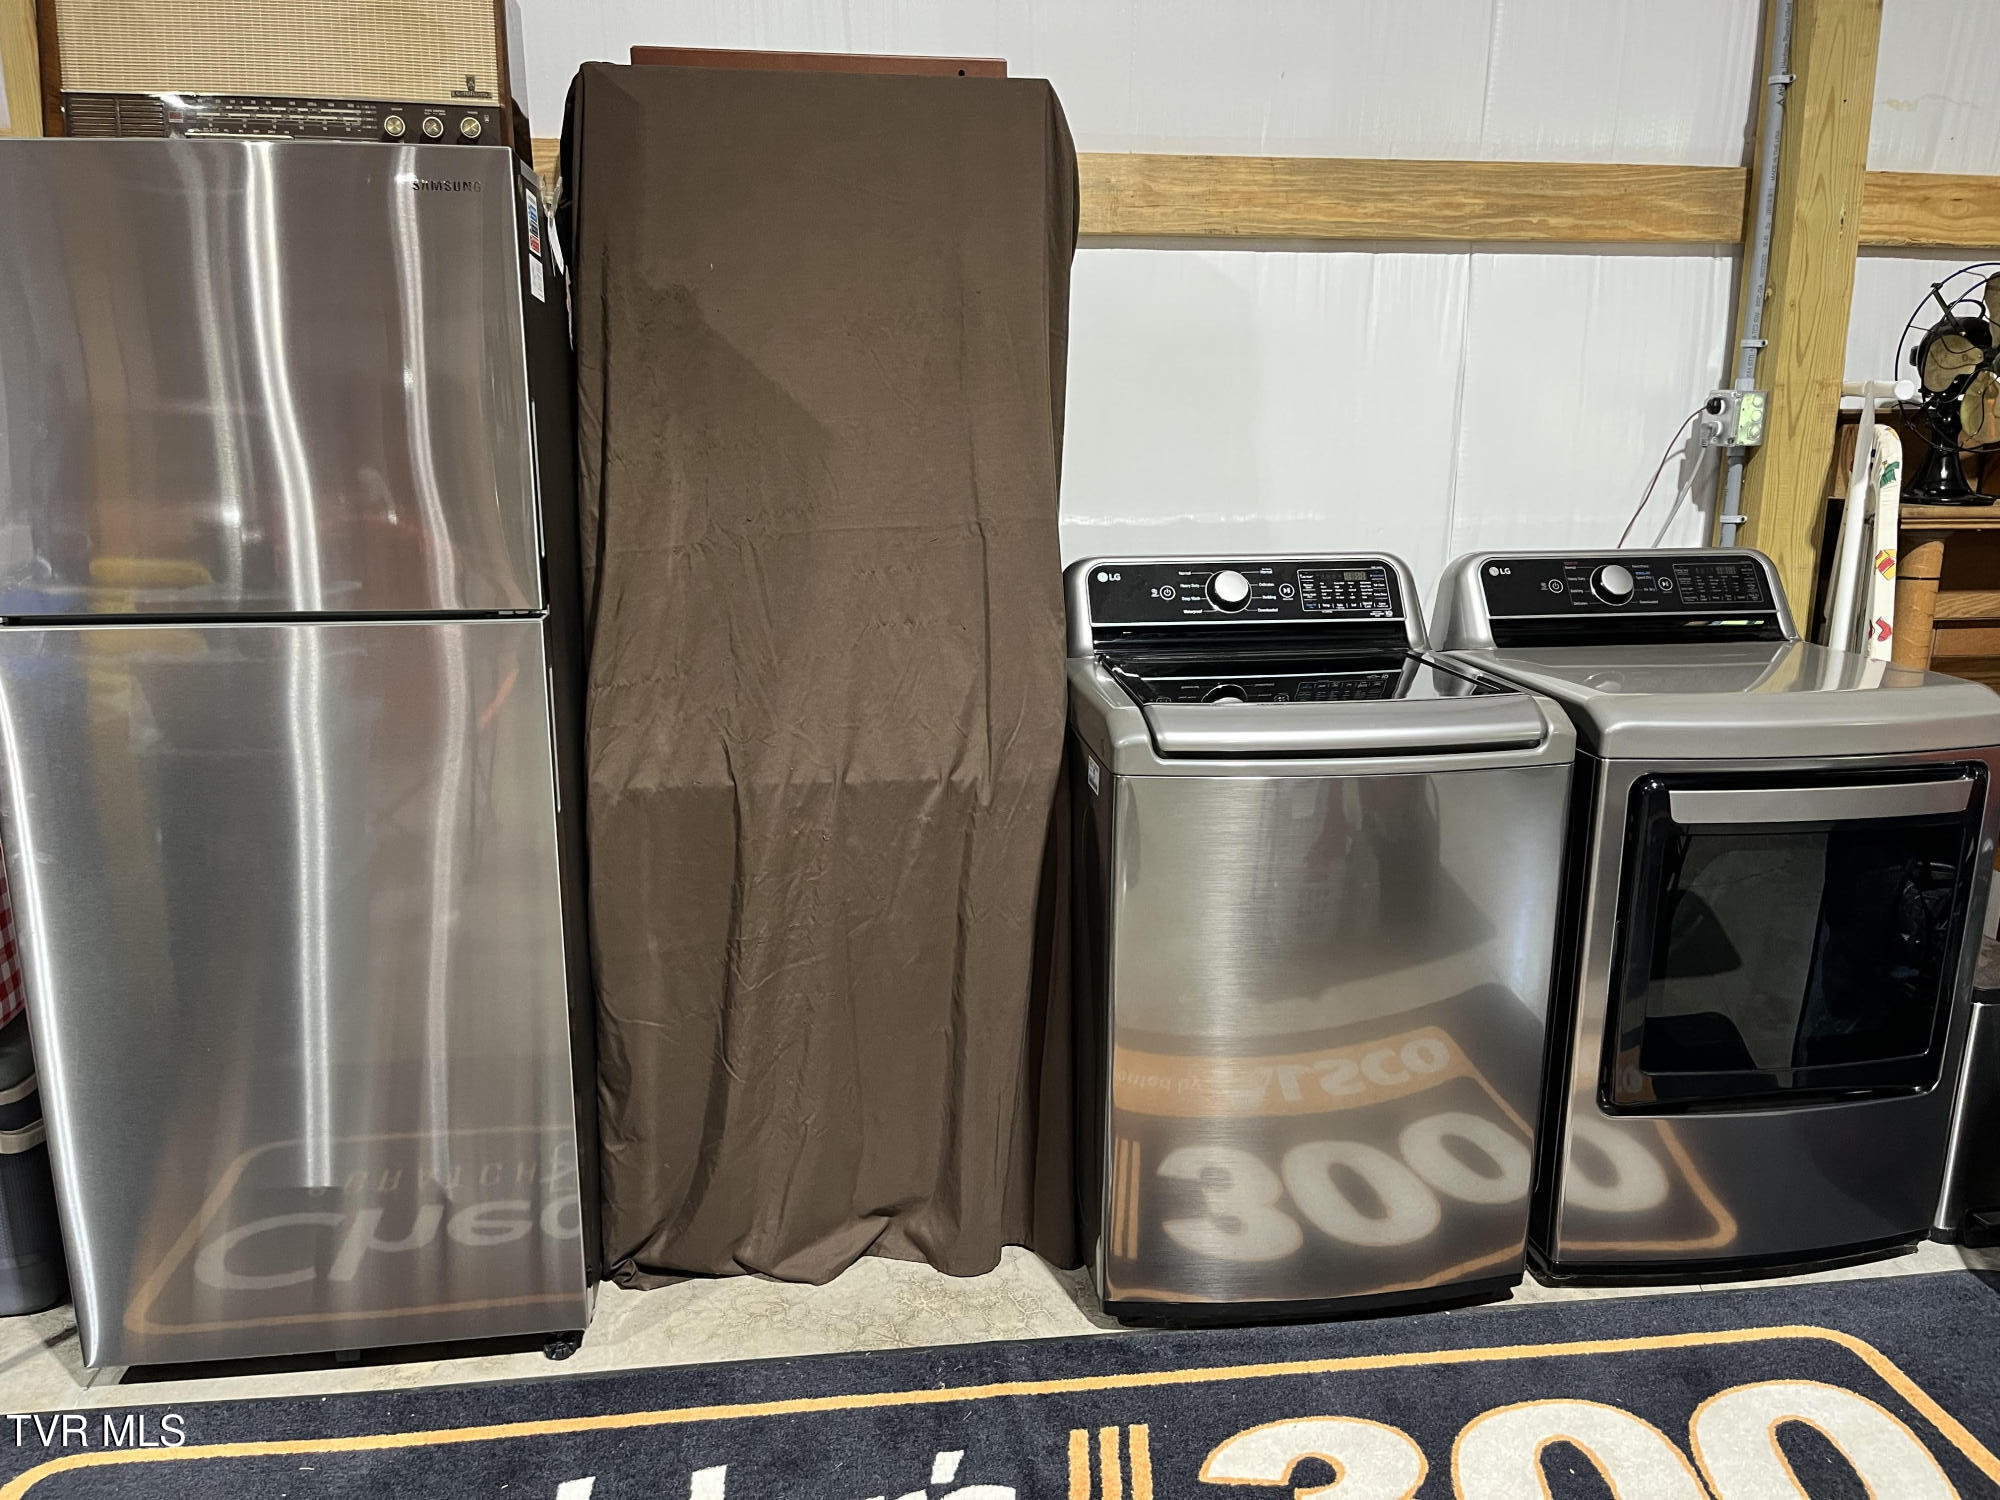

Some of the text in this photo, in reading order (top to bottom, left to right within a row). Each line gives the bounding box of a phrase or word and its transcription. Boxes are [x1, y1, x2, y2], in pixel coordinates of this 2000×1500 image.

[412, 180, 482, 192] SAMSUNG
[1499, 567, 1511, 575] LG
[1108, 573, 1121, 581] LG
